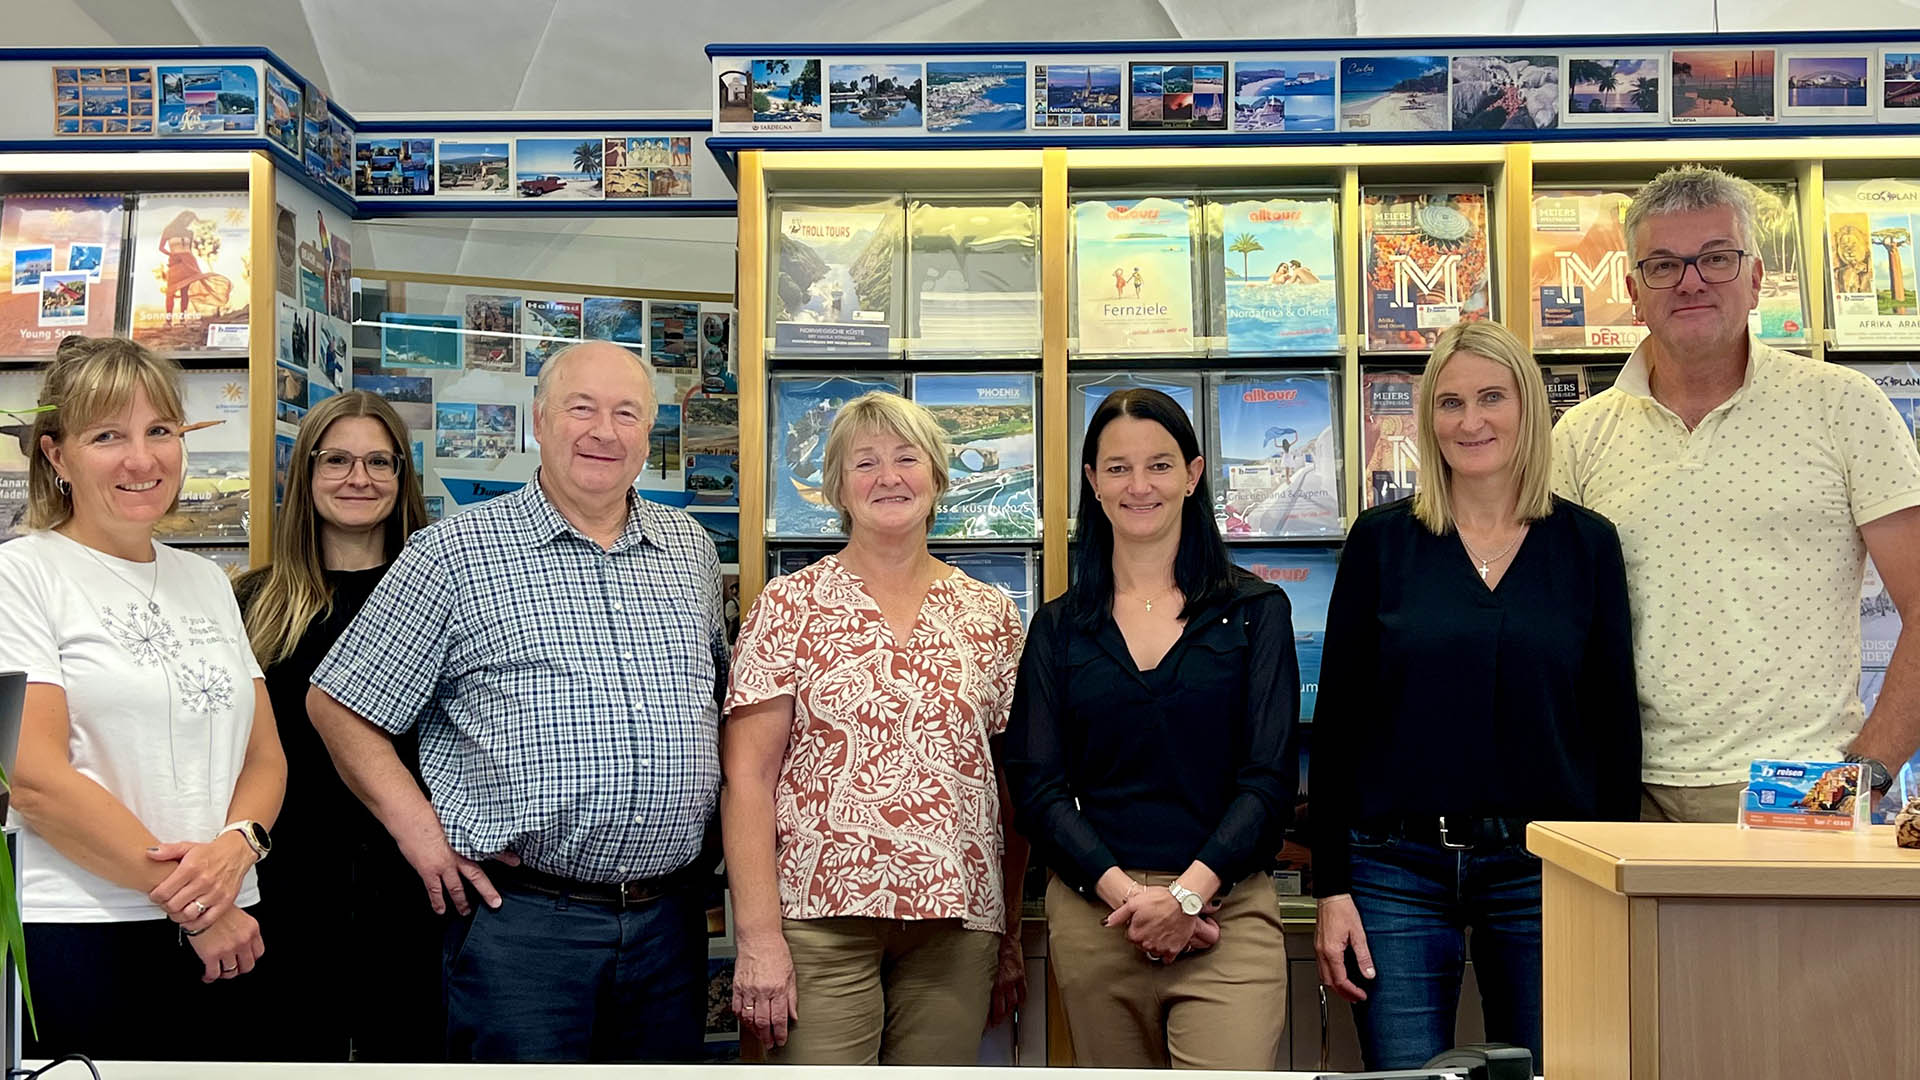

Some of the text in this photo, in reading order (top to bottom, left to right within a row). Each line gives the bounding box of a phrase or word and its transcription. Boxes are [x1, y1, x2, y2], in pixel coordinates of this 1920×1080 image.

[1048, 106, 1082, 114] Antwerpen
[377, 186, 412, 195] BERLIN
[1249, 208, 1303, 223] alltours
[1375, 211, 1412, 221] MEIERS
[1539, 208, 1577, 218] MEIERS
[802, 225, 851, 238] TROLL TOURS
[527, 301, 580, 312] Holland
[1103, 302, 1168, 318] Fernziele
[1230, 306, 1330, 319] Nordafrika & Orient
[1858, 320, 1892, 329] AFRIKA
[19, 328, 51, 340] Young
[976, 388, 1020, 399] PHOENIX
[1243, 388, 1298, 403] alltours
[1373, 391, 1410, 401] MEIERS
[1776, 768, 1804, 777] reisen
